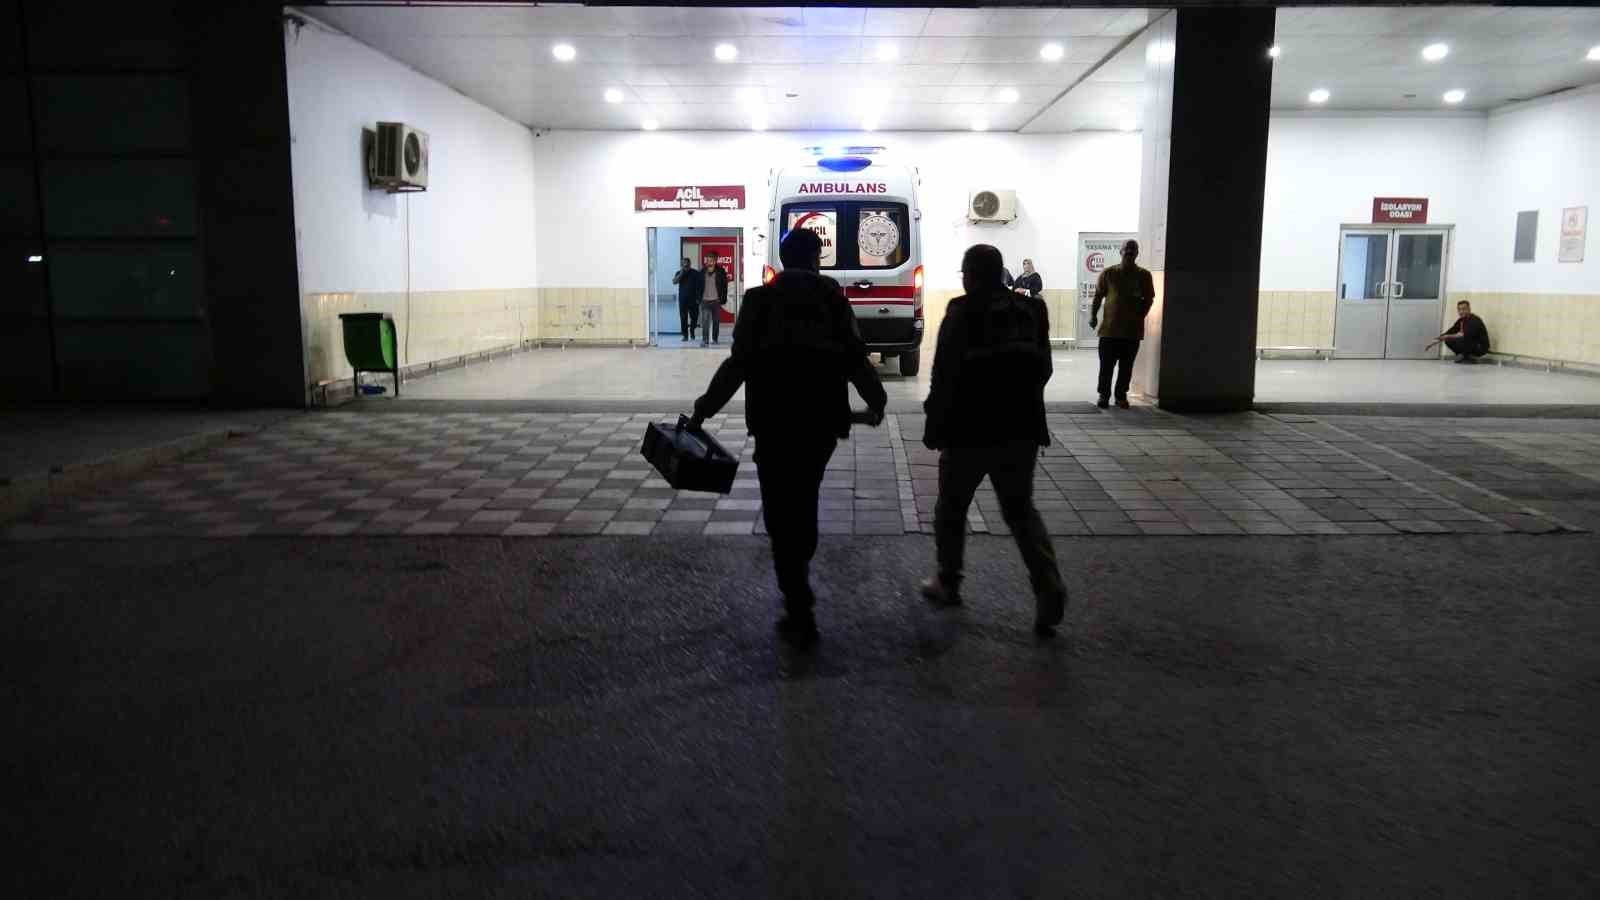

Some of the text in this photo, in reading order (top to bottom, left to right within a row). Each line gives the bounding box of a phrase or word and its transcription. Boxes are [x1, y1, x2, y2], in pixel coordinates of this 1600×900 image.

[676, 186, 703, 199] ACİL
[799, 183, 887, 193] AMBULANS
[1381, 201, 1422, 211] İZOLASYON
